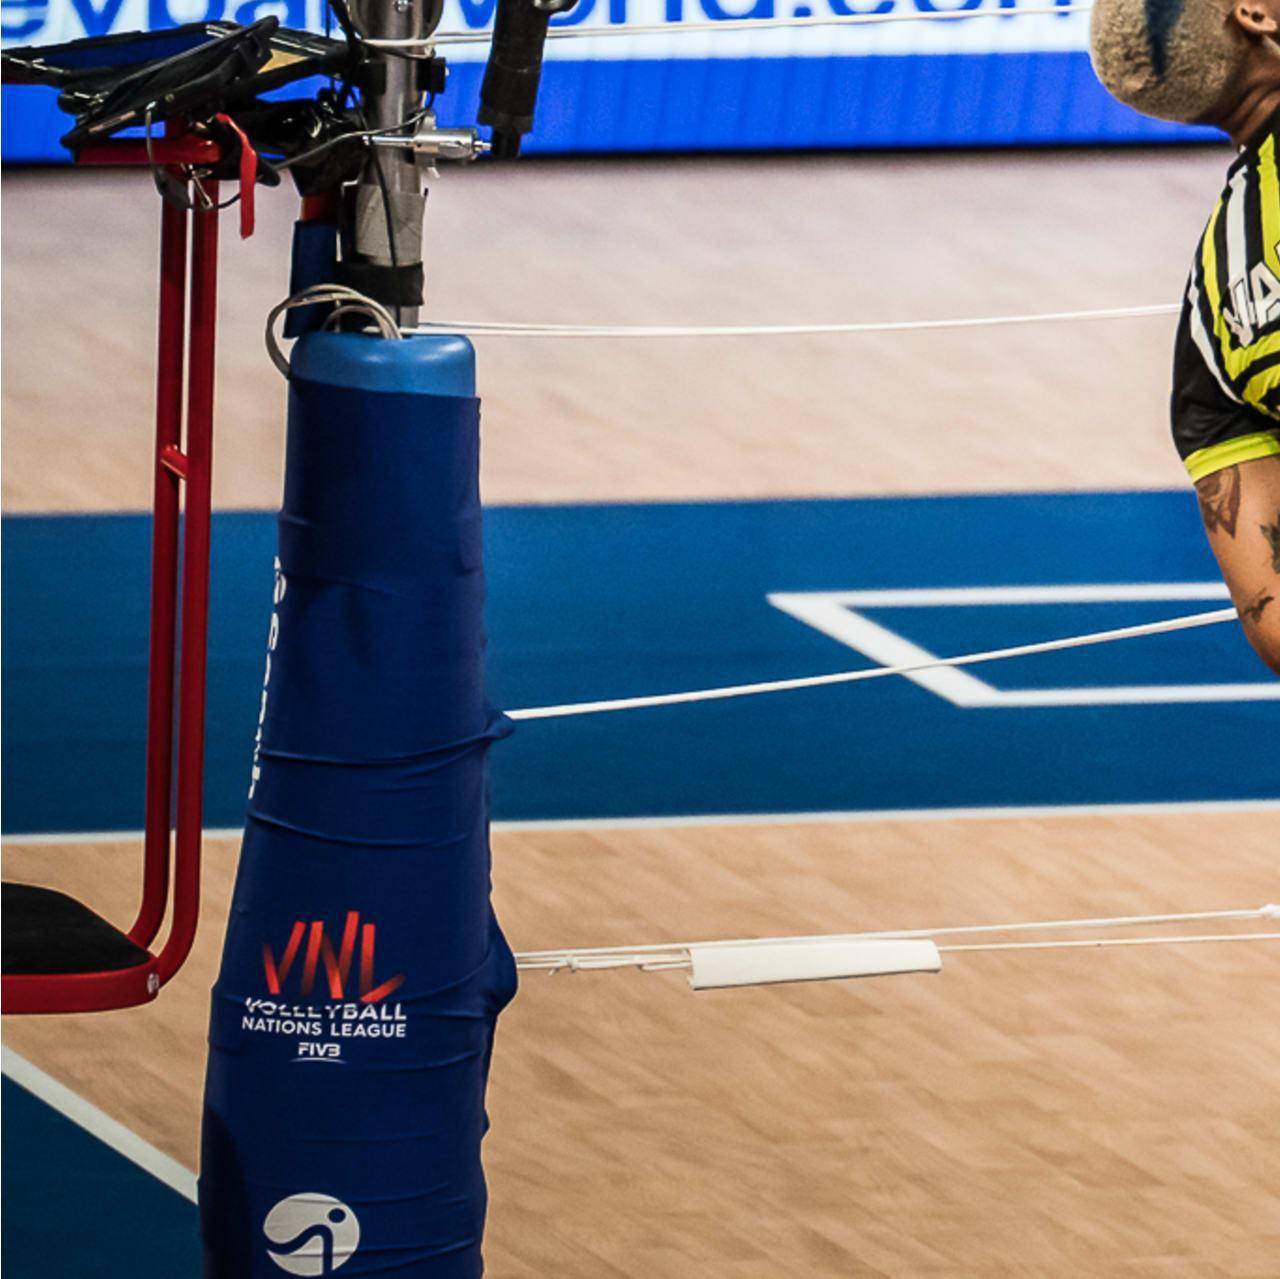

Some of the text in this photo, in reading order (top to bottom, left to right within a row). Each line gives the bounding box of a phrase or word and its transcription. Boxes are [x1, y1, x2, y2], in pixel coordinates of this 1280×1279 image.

[261, 910, 406, 1004] VNL
[241, 1015, 408, 1038] NATIONS LEAGUE
[297, 1041, 342, 1058] FIVB
